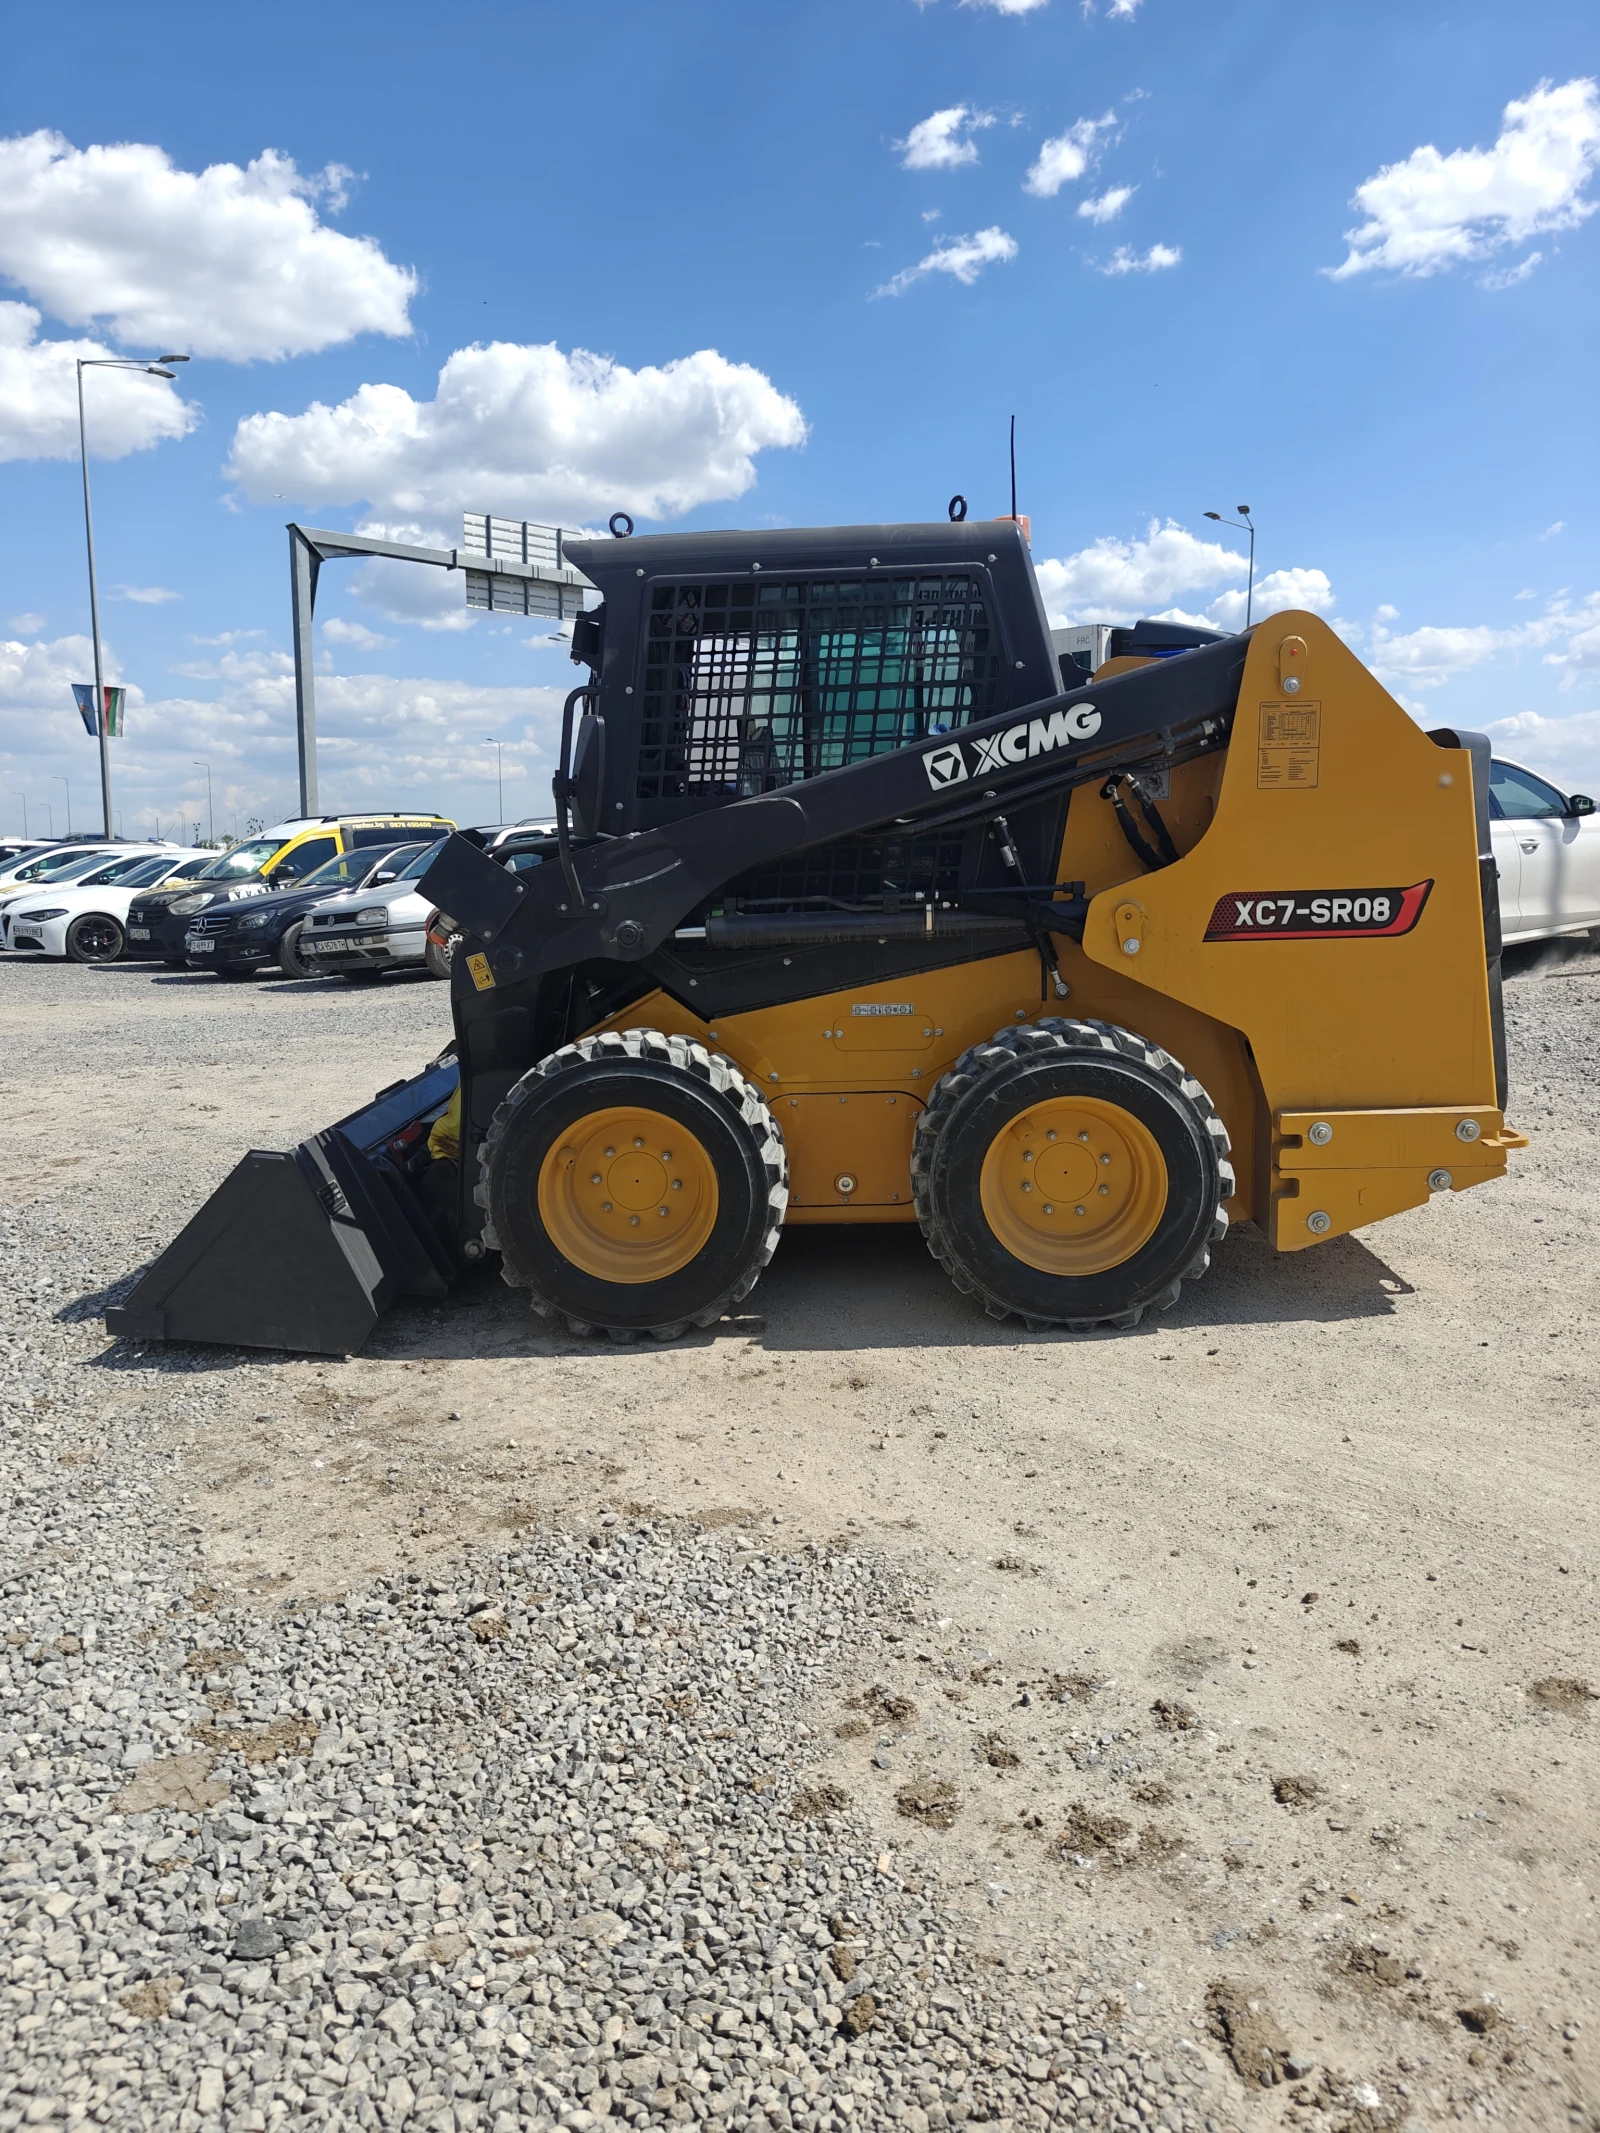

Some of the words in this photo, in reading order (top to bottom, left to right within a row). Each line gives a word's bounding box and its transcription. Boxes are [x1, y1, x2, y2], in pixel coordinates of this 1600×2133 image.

[1076, 636, 1090, 645] FRC
[970, 702, 1102, 778] XCMG
[1234, 896, 1391, 927] XC7-SR08
